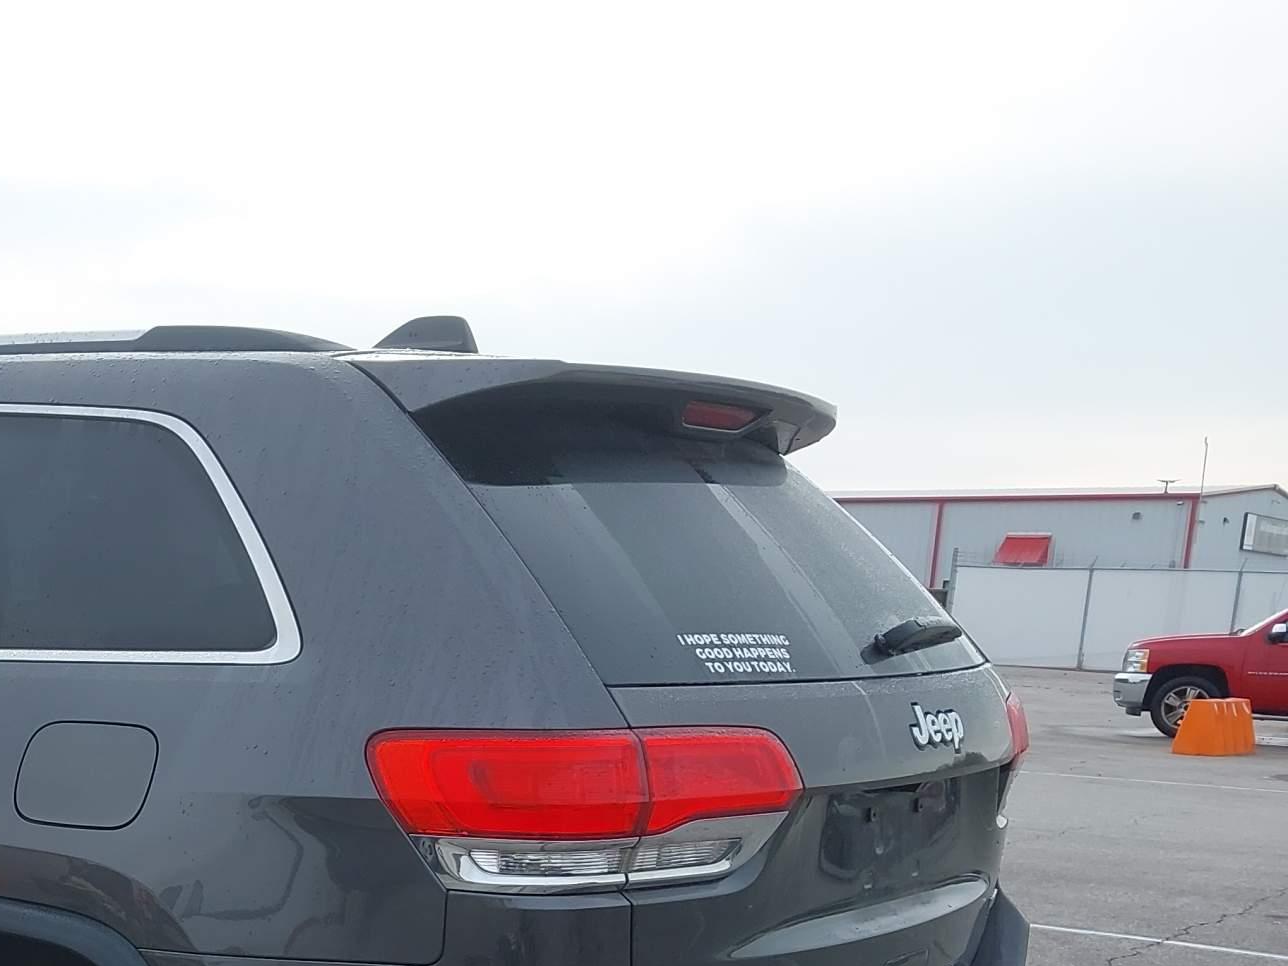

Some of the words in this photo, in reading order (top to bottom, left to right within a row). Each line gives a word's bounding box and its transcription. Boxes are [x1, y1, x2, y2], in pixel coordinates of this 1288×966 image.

[677, 634, 686, 646] I
[683, 634, 721, 645] HOPE
[720, 633, 790, 646] SOMETHING
[695, 647, 733, 660] GOOD
[733, 647, 791, 659] HAPPENS
[705, 661, 725, 673] TO
[723, 661, 753, 673] YOU
[910, 702, 964, 753] Jeep
